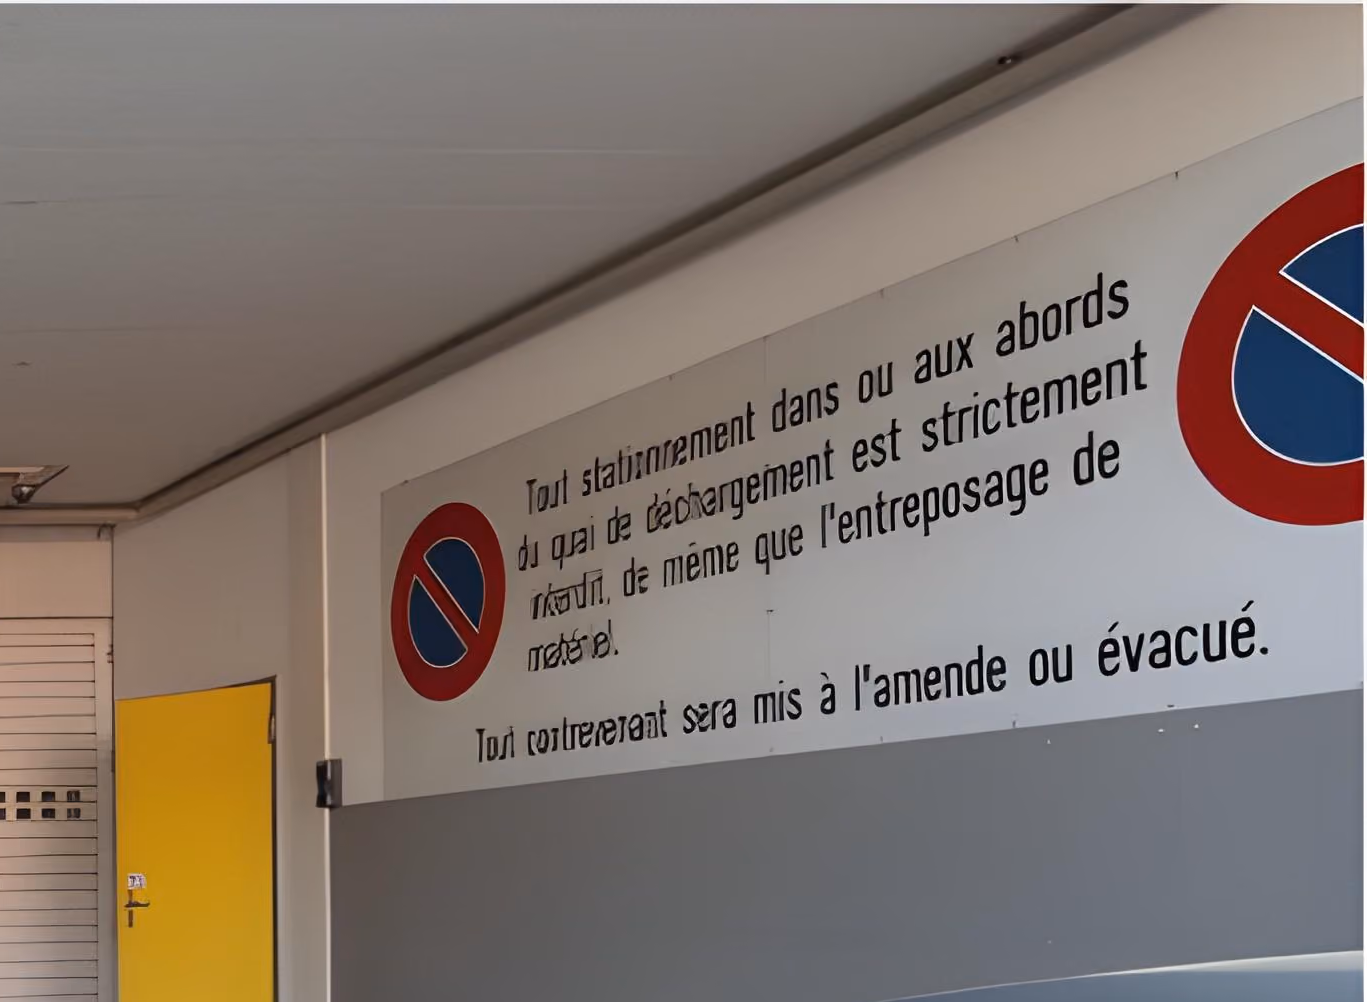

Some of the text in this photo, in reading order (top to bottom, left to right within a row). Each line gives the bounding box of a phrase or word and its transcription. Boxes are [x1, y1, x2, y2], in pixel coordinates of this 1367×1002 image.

[772, 382, 840, 432] dans
[858, 361, 893, 404] ou
[914, 332, 974, 384] aux
[995, 272, 1129, 358] abords
[607, 506, 631, 545] de
[851, 418, 901, 473] est
[922, 339, 1148, 452] strictement
[623, 557, 649, 597] de
[663, 542, 740, 588] même
[755, 523, 804, 576] que
[820, 458, 1050, 549] l'entreposage
[1073, 430, 1120, 486] de
[682, 698, 737, 735] sera
[754, 680, 803, 724] mis
[820, 672, 836, 716] à
[854, 644, 1008, 712] l'amende
[1028, 644, 1074, 688] ou
[1097, 600, 1270, 678] évacué.
